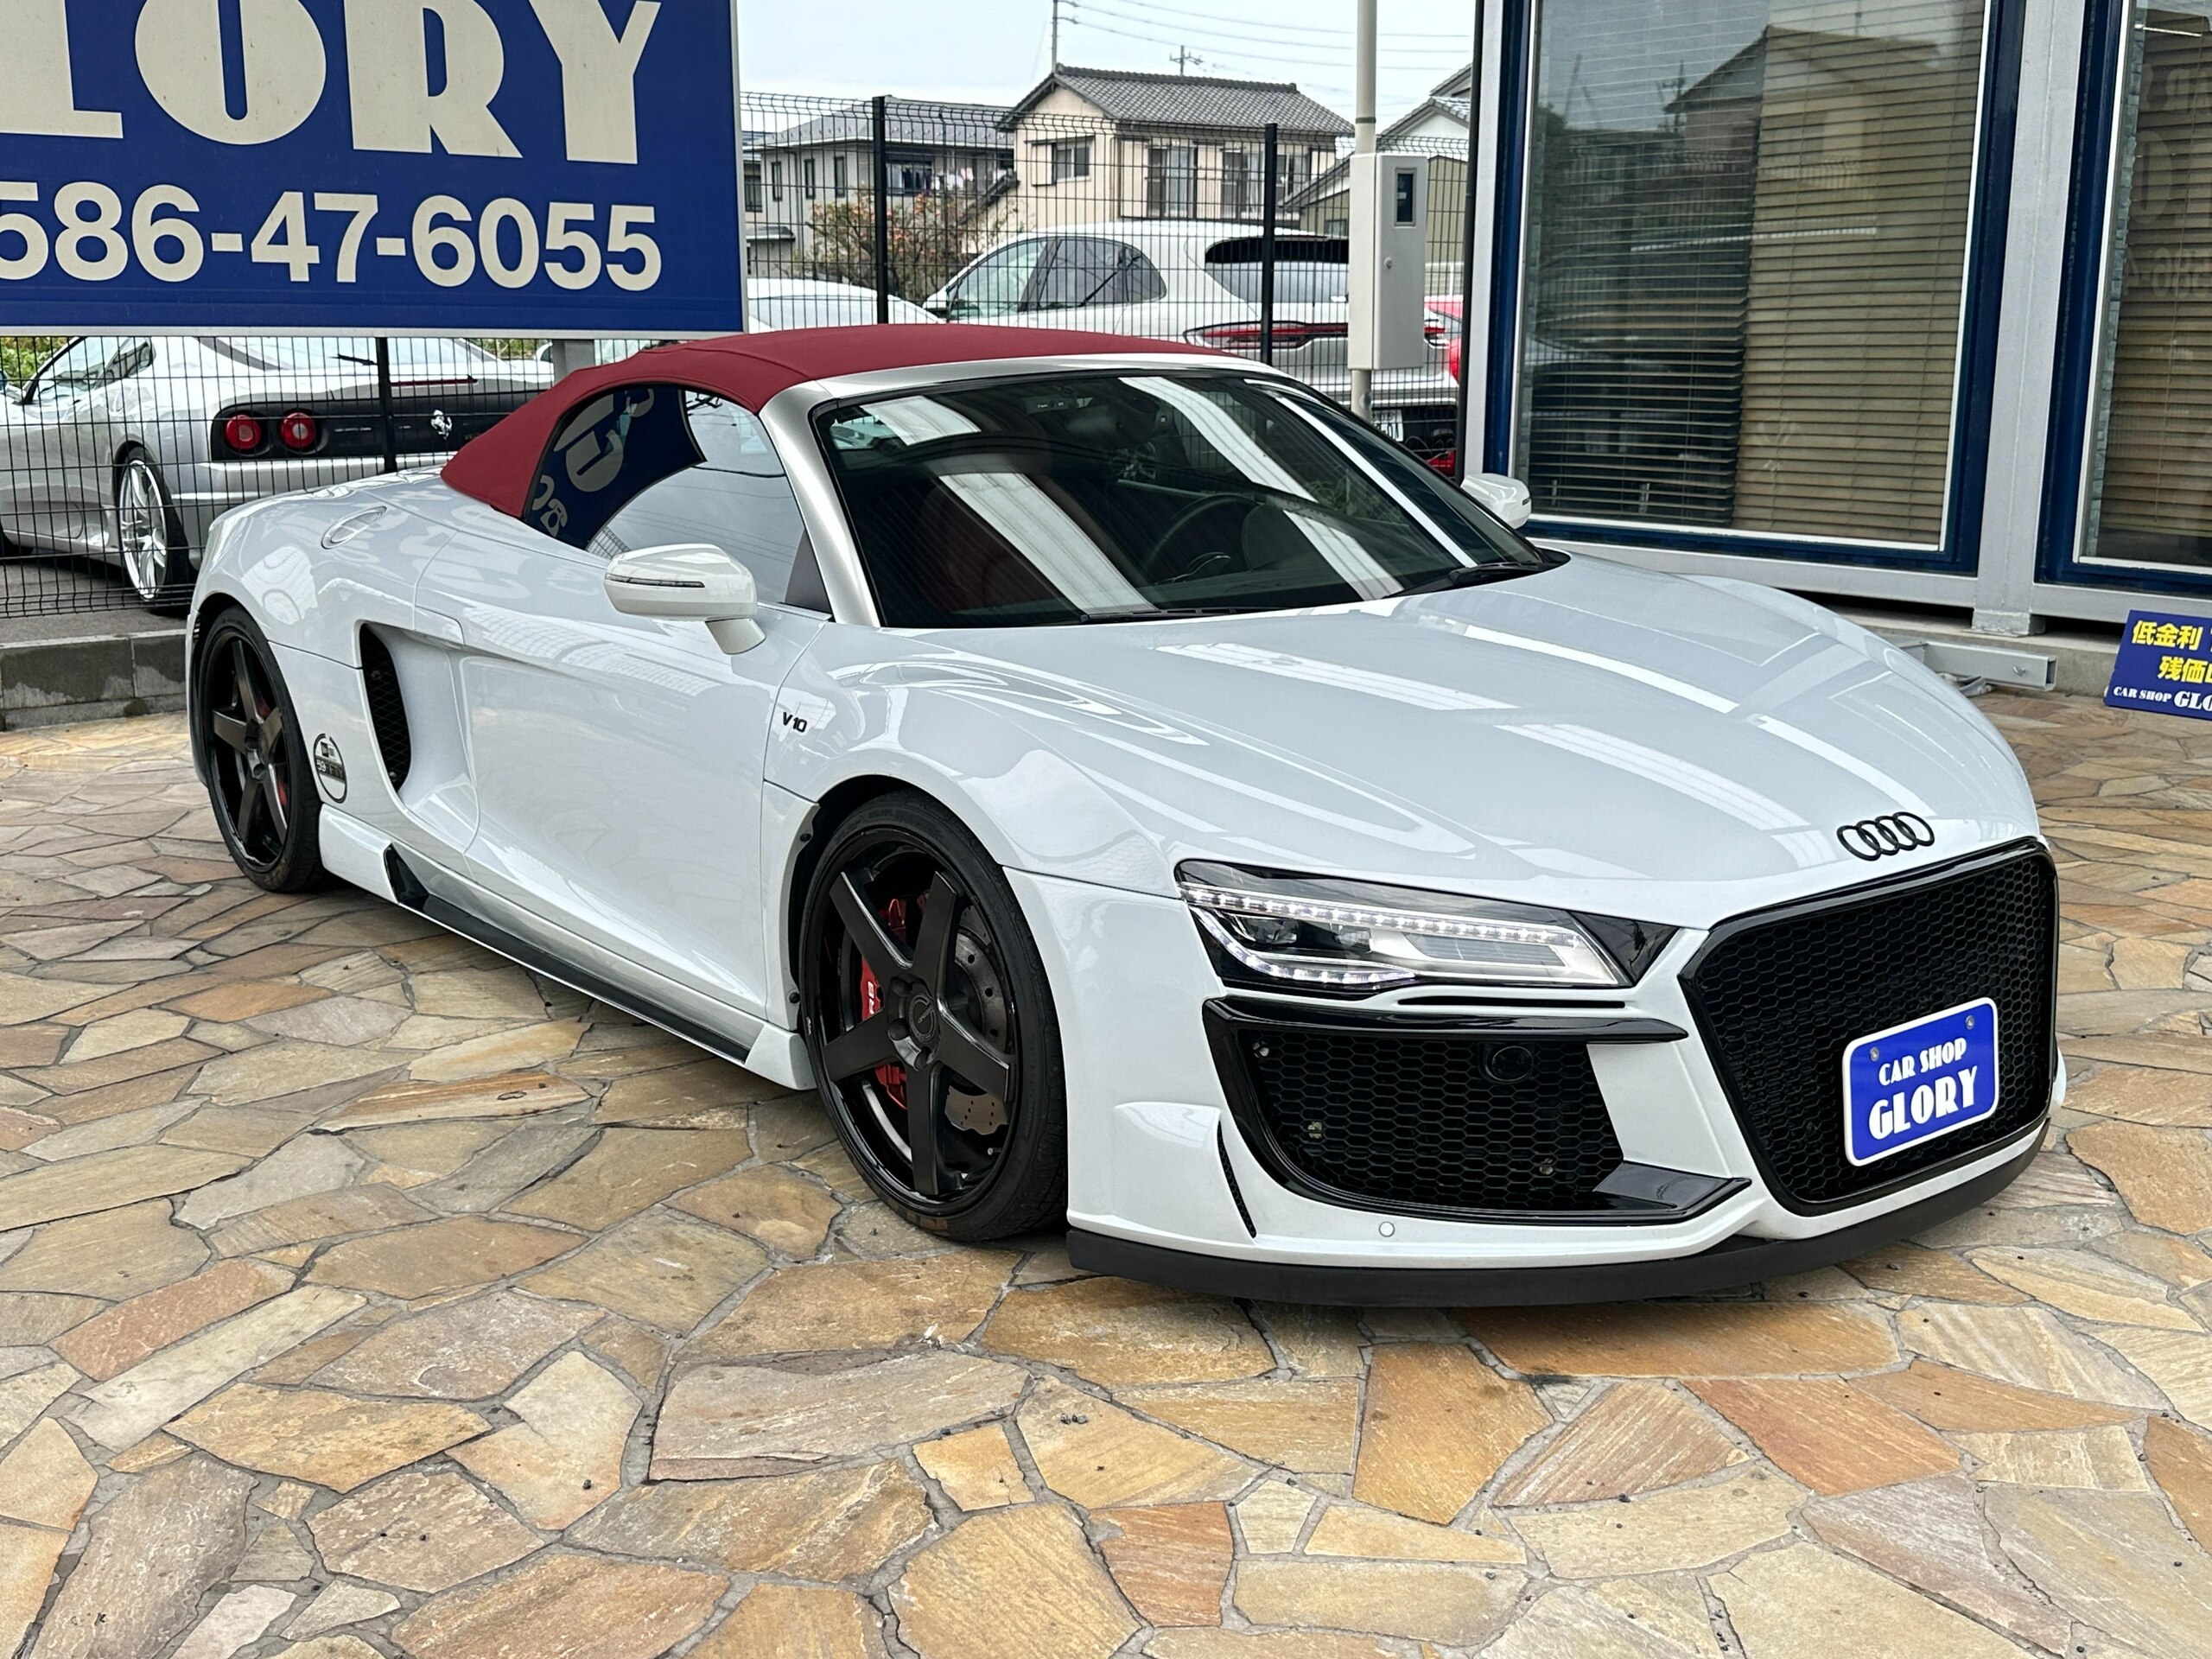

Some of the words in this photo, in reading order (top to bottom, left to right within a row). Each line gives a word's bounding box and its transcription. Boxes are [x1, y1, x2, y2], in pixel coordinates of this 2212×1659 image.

[0, 181, 662, 292] 586-47-6055
[2132, 620, 2203, 651] 低金利
[2113, 685, 2138, 699] CAR
[2139, 689, 2172, 703] SHOP
[783, 711, 808, 733] V10
[1878, 1055, 1916, 1086] CAR
[1919, 1037, 1967, 1073] SHOP
[1868, 1065, 1979, 1141] GLORY
